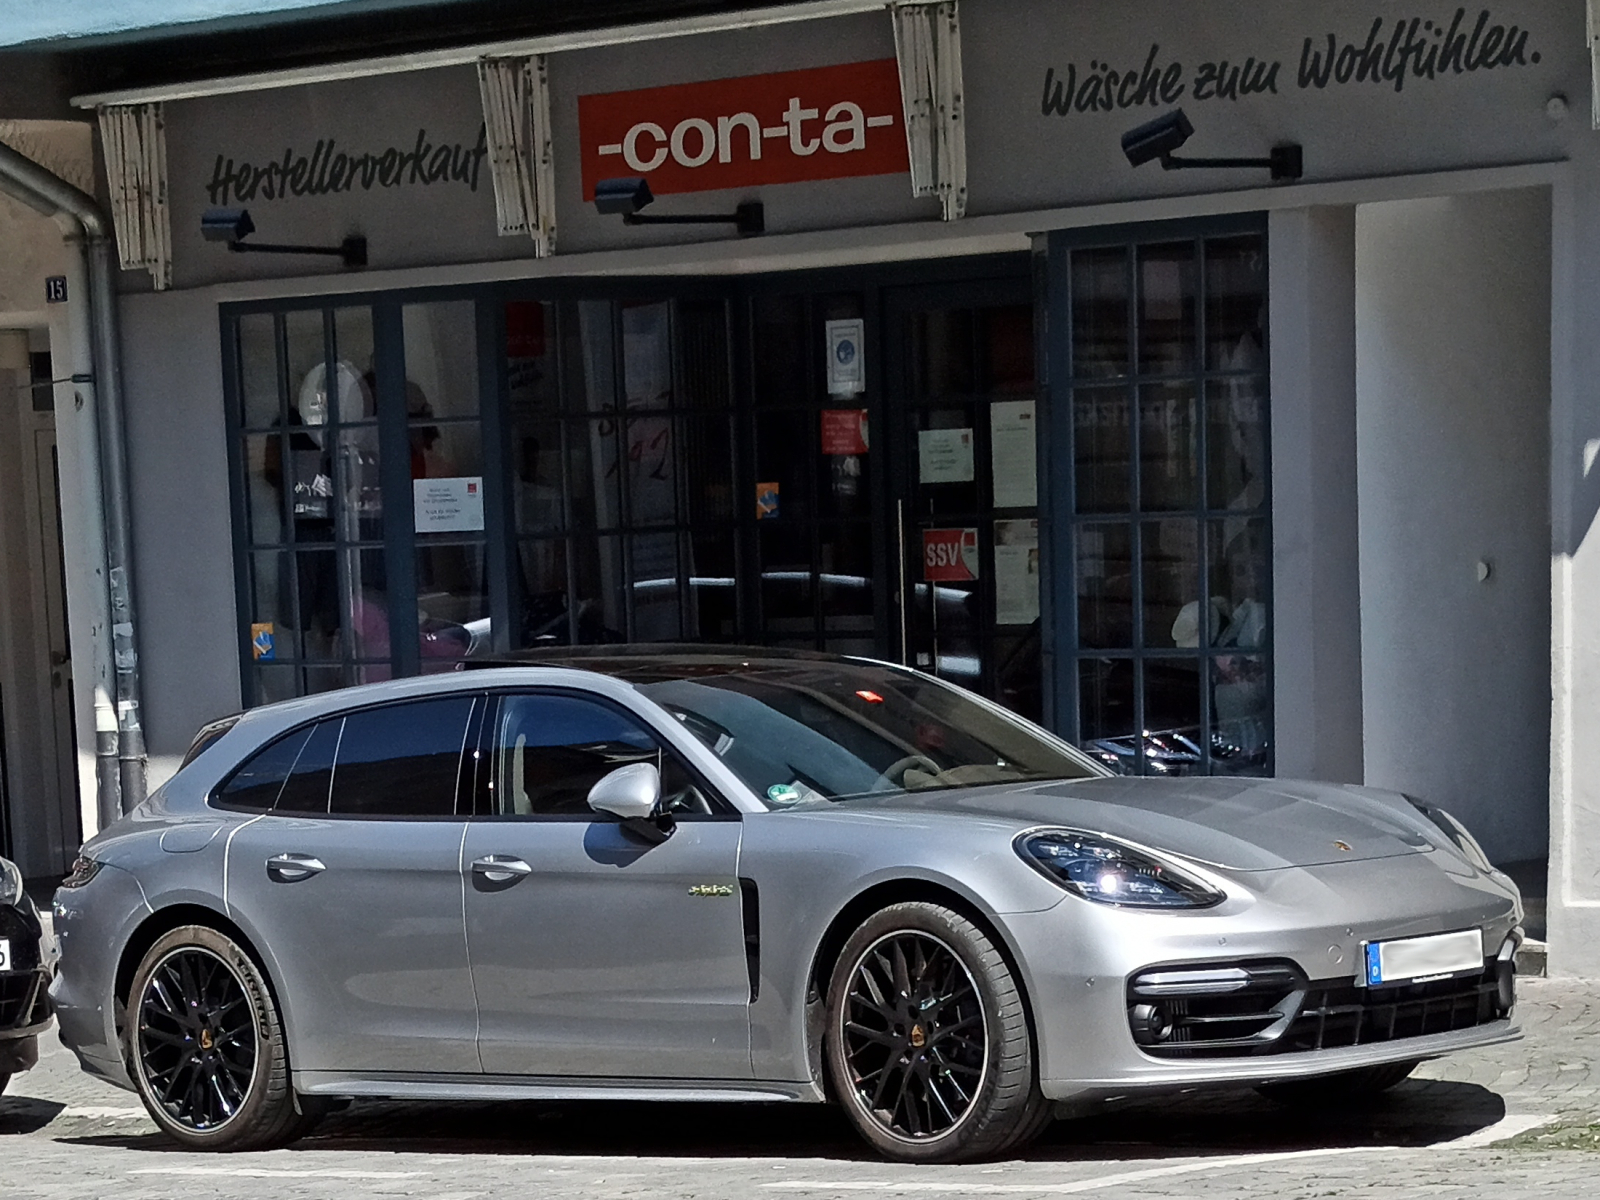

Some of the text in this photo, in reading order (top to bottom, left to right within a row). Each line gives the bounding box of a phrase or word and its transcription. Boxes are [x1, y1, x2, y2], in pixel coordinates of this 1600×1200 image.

[1041, 7, 1542, 117] Wäsche zum Wohlfühlen.
[205, 121, 488, 206] Herstellerverkauf
[50, 280, 63, 300] 15
[926, 542, 959, 567] SSV
